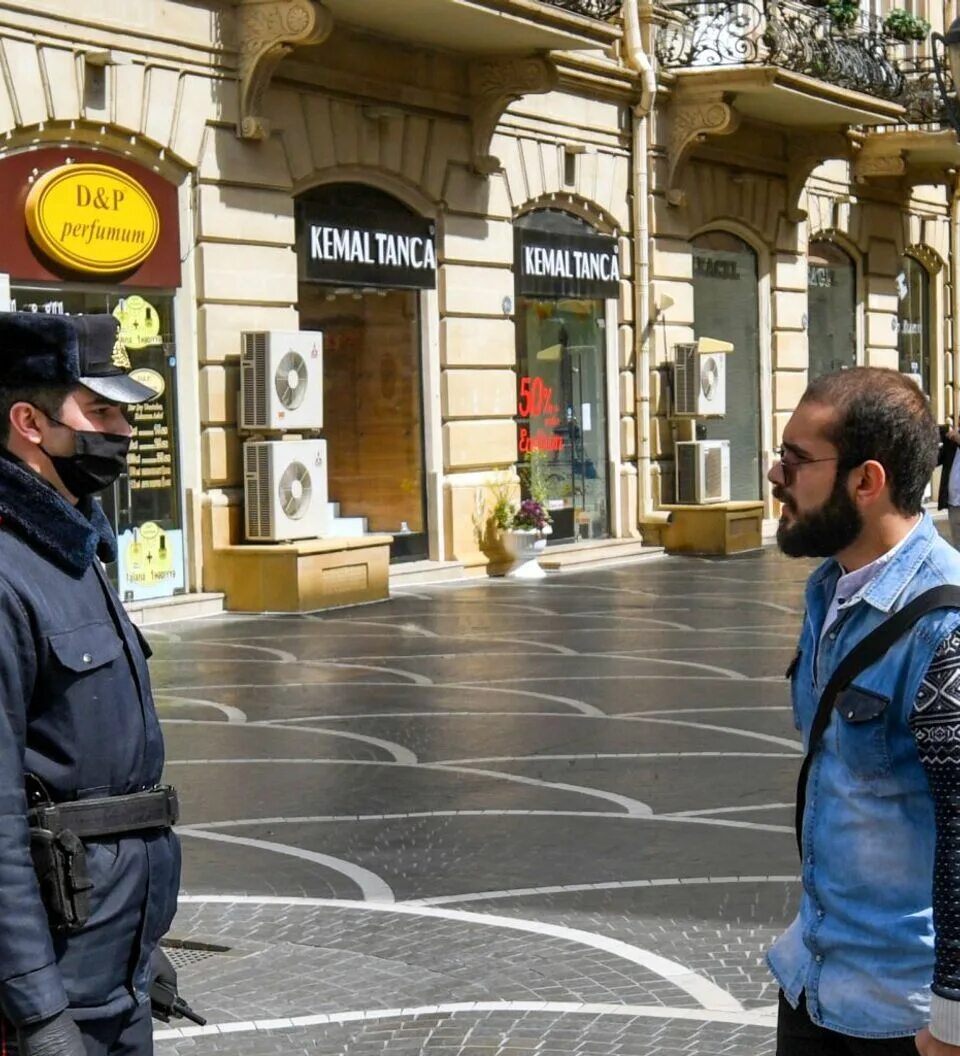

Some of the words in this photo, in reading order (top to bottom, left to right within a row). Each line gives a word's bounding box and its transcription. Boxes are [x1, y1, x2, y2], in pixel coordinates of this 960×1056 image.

[75, 184, 125, 212] D&P
[60, 219, 146, 245] perfumum
[310, 225, 376, 264] KEMAL
[375, 232, 437, 270] TANCA
[525, 246, 574, 278] KEMAL
[573, 250, 620, 281] TANCA
